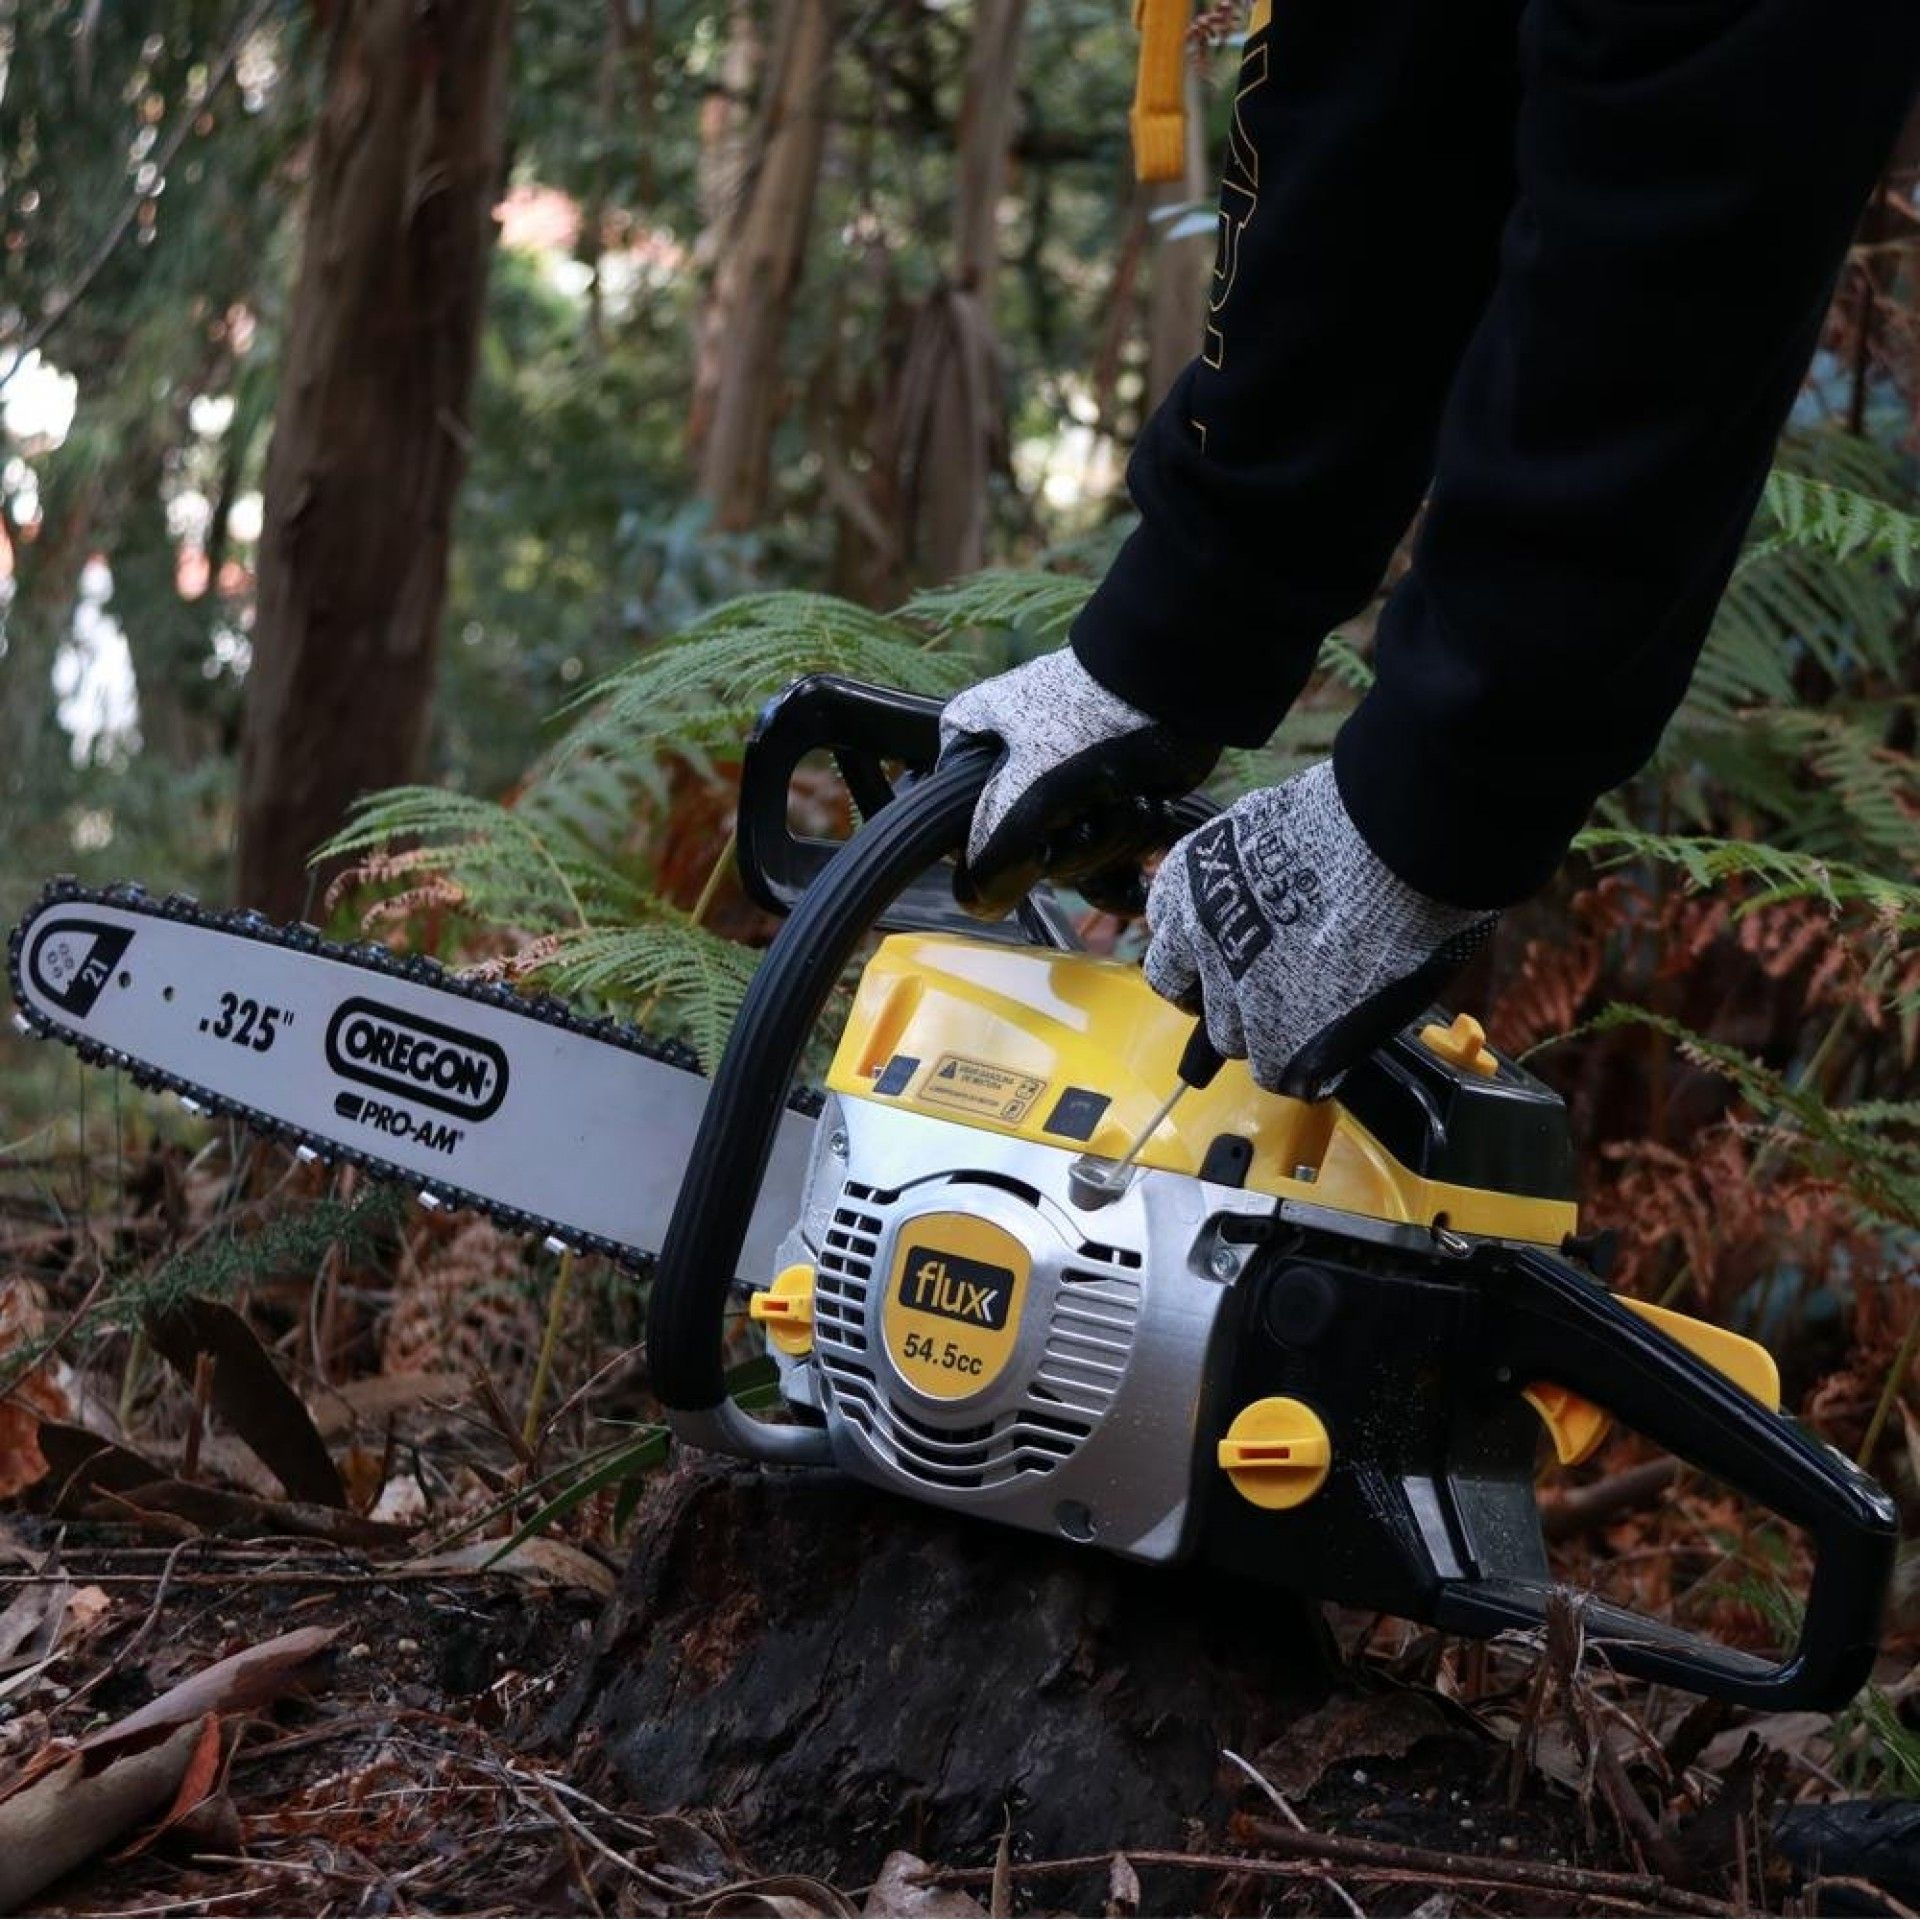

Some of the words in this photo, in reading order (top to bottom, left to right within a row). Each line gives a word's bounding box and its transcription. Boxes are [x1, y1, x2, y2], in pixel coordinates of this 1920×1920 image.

[81, 961, 109, 988] 21
[344, 1019, 492, 1100] OREGON
[360, 1100, 464, 1155] PRO-AM
[903, 1333, 983, 1376] 54.5cc
